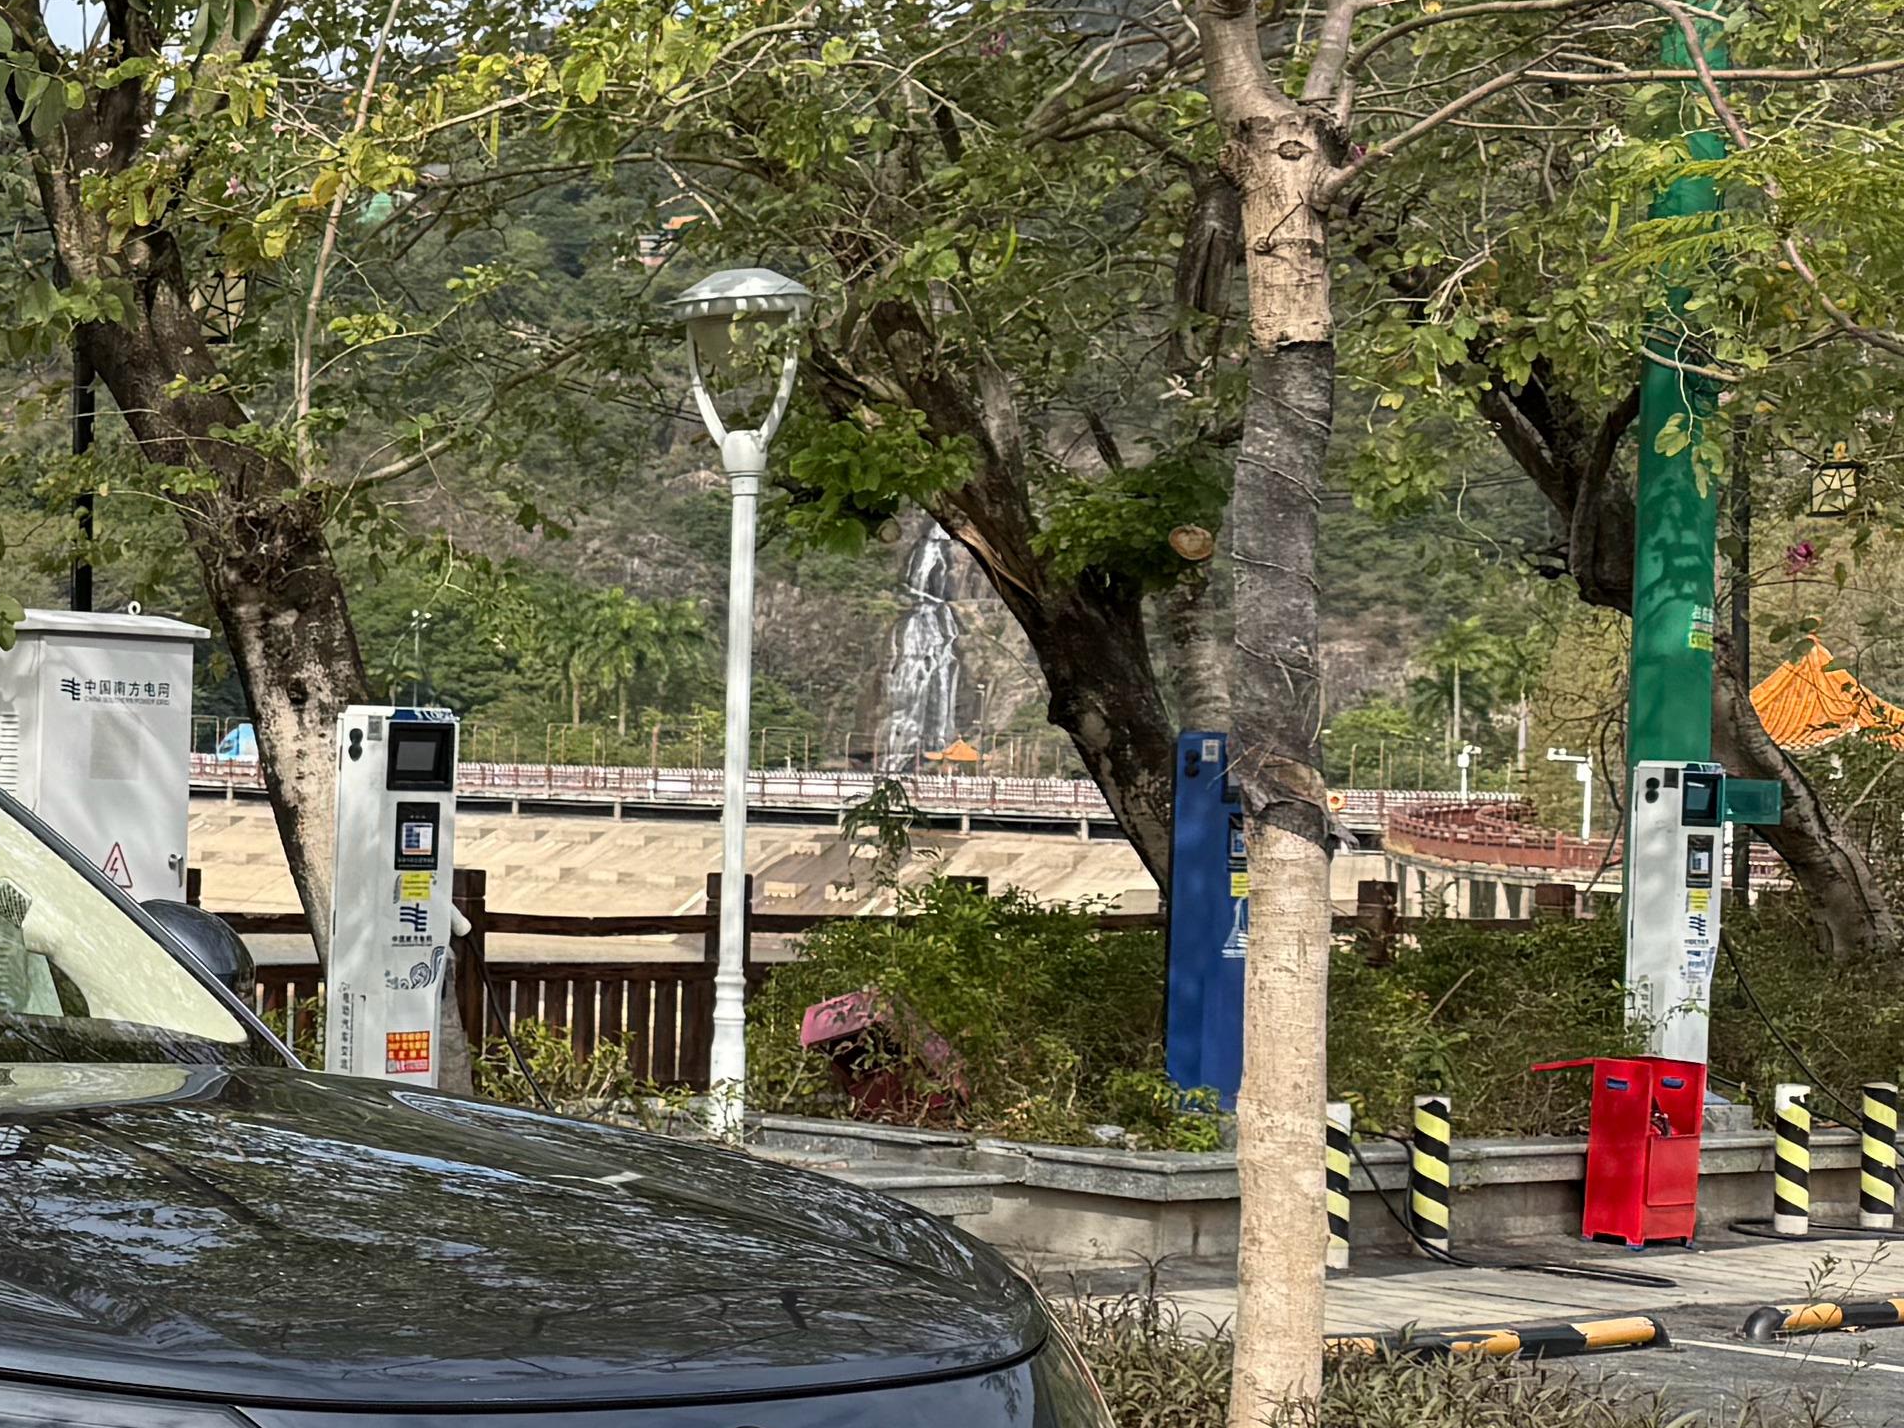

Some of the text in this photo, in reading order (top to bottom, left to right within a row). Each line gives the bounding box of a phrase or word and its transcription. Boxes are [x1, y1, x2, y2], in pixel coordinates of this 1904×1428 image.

[84, 679, 170, 698] 中国南方电网
